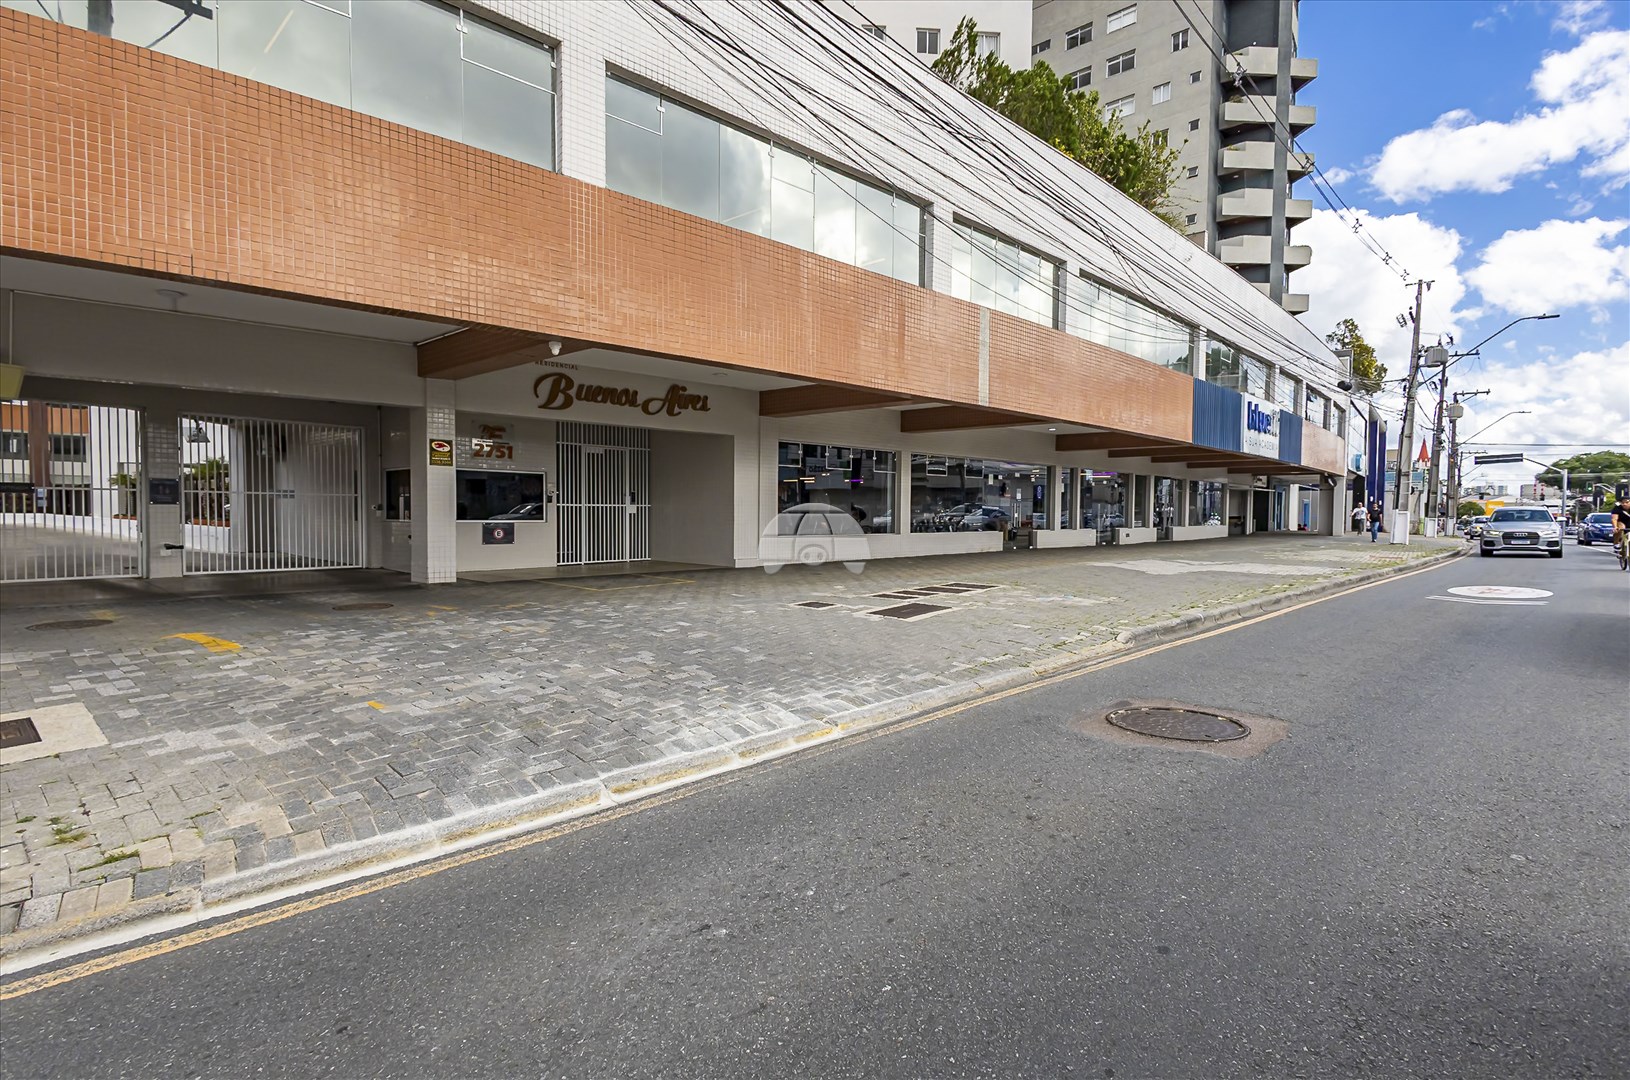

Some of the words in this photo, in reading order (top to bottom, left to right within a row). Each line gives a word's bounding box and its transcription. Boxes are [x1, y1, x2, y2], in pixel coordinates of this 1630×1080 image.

[533, 372, 640, 410] Buenos
[641, 383, 711, 417] Aires
[473, 442, 513, 460] 2751
